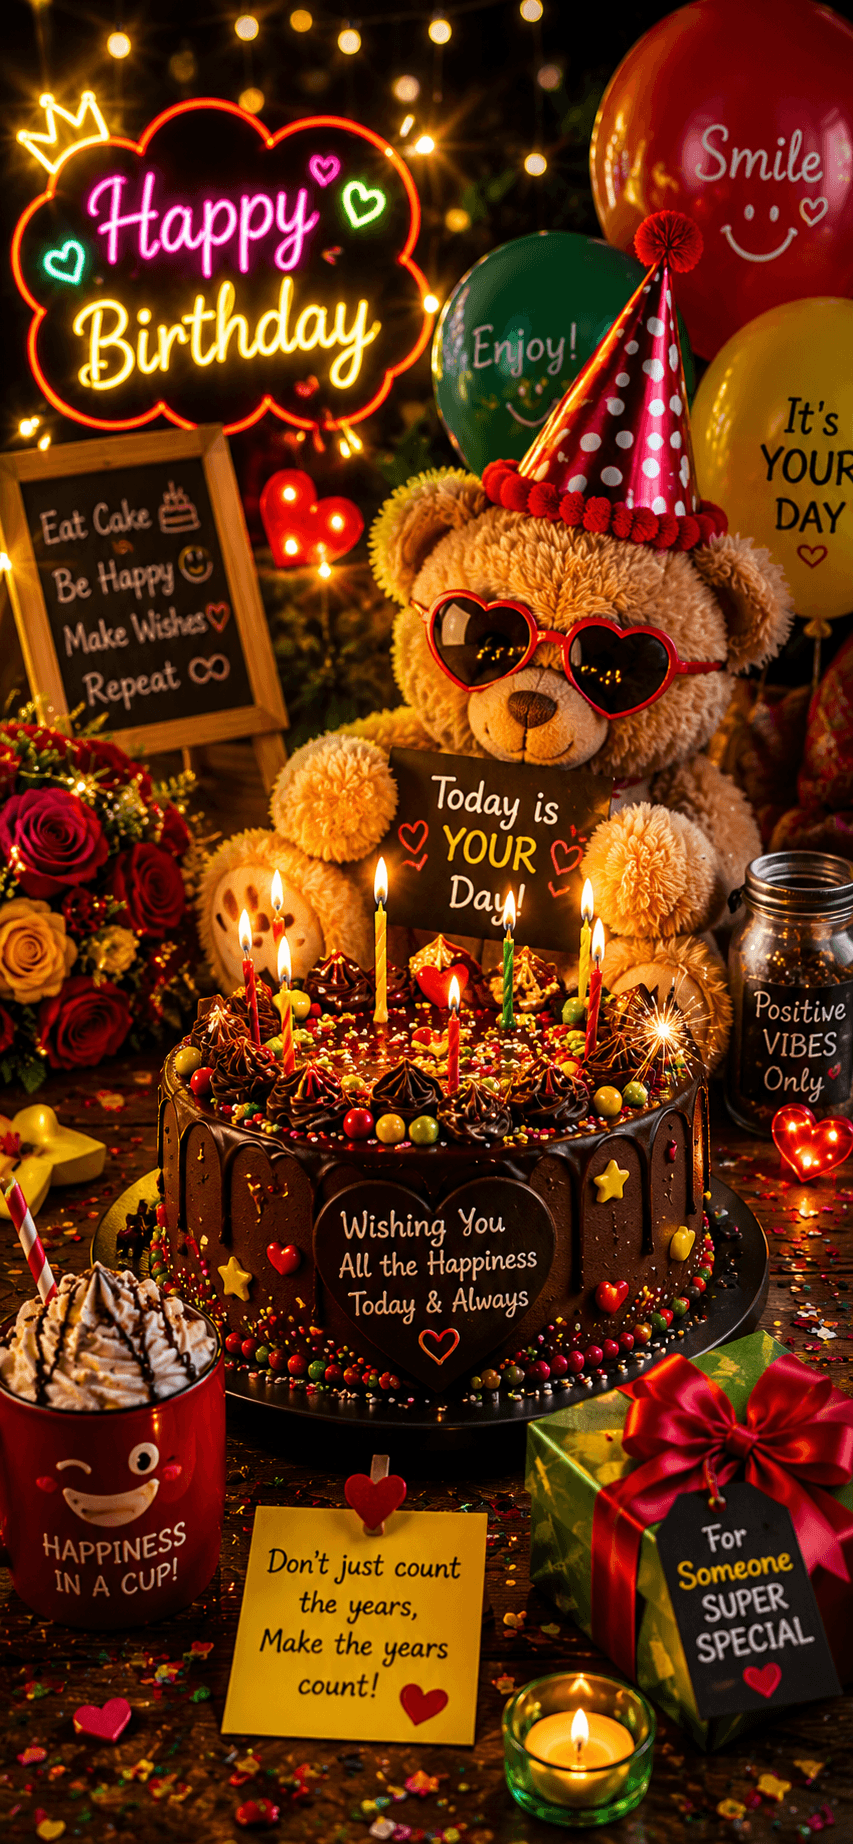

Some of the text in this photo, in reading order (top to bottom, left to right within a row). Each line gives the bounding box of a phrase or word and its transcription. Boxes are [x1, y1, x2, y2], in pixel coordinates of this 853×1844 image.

[695, 124, 823, 184] Smile
[87, 171, 320, 279] Happy
[72, 276, 382, 390] Birthday
[471, 322, 577, 377] Enjoy!
[784, 397, 839, 436] It's
[760, 443, 853, 487] YOUR
[39, 498, 152, 545] Eat Cake
[775, 497, 846, 535] DAY
[51, 558, 175, 604] Be Happy
[62, 606, 208, 657] Make Wishes
[82, 660, 181, 711] Repeat
[431, 775, 559, 831] Today is
[442, 824, 537, 874] YOUR
[449, 874, 526, 926] Day!
[762, 1028, 837, 1058] VIBES
[763, 1065, 825, 1103] Only
[340, 1207, 506, 1247] Wishing You
[338, 1249, 538, 1282] All the Happiness
[347, 1286, 530, 1325] Today & Always
[42, 1521, 187, 1565] HAPPINESS
[701, 1523, 747, 1553] For
[54, 1557, 178, 1597] IN A CUP!
[266, 1548, 461, 1585] Don't just count
[676, 1552, 794, 1590] Someone
[299, 1590, 418, 1625] the years,
[701, 1582, 790, 1623] SUPER
[259, 1628, 449, 1668] Make the years
[695, 1616, 816, 1664] SPECIAL
[297, 1672, 379, 1699] count!
